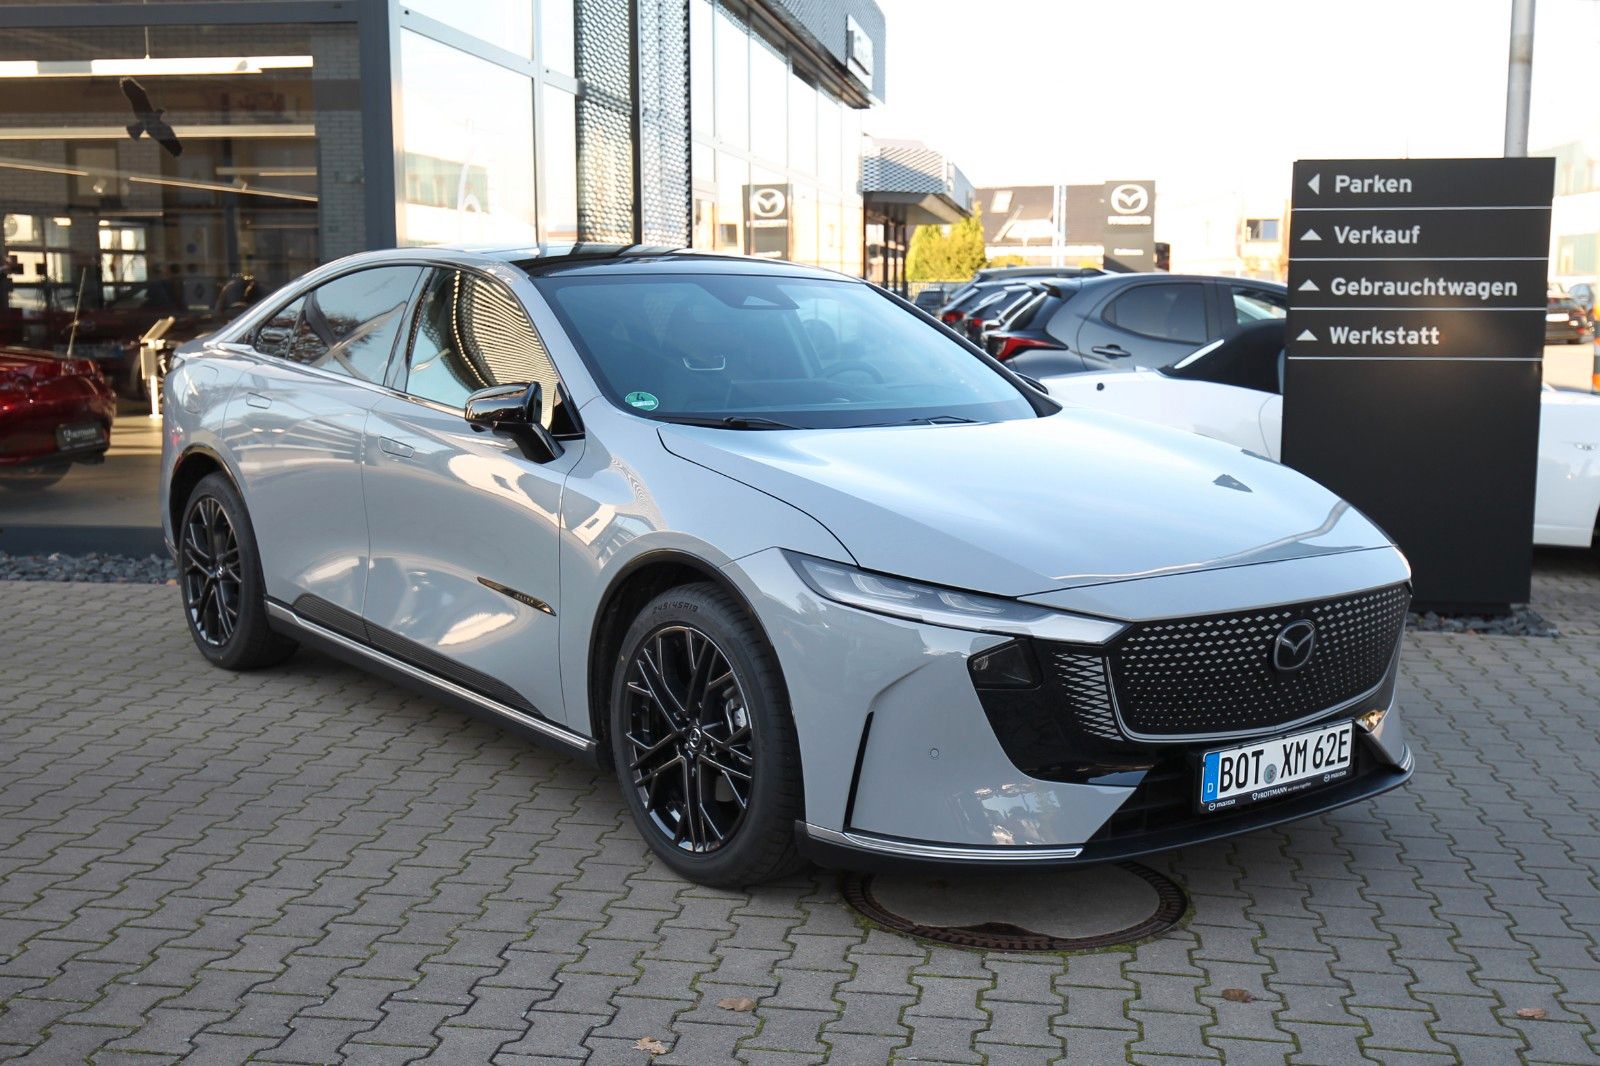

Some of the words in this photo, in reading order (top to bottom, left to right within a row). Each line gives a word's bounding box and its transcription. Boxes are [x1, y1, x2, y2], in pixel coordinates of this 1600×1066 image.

[1335, 175, 1413, 193] Parken
[1334, 226, 1421, 244] Verkauf
[1330, 278, 1519, 300] Gebrauchtwagen
[1329, 327, 1440, 345] Werkstatt
[1219, 749, 1264, 793] BOT
[1280, 738, 1308, 779] XM
[1312, 729, 1350, 769] 62E
[1207, 782, 1214, 793] D
[1216, 799, 1236, 808] mazda
